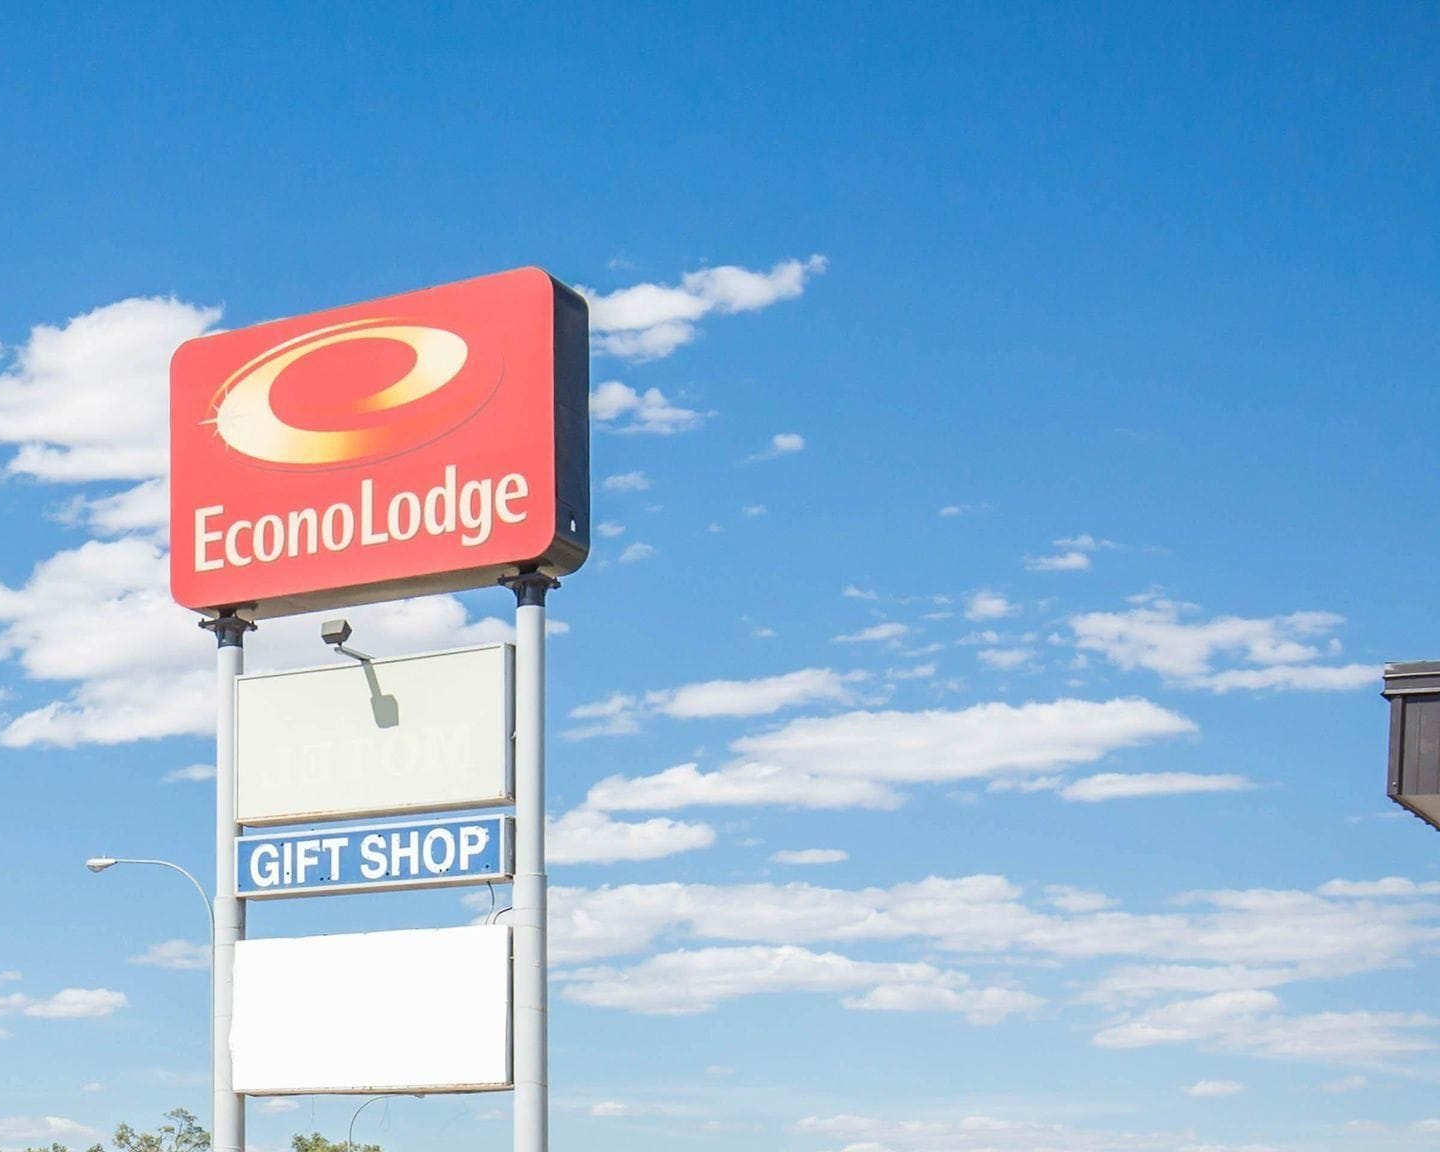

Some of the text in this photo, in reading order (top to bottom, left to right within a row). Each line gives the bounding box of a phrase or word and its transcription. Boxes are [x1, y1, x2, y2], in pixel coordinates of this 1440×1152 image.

[193, 463, 529, 574] EconoLodge
[249, 825, 489, 888] GIFT SHOP
